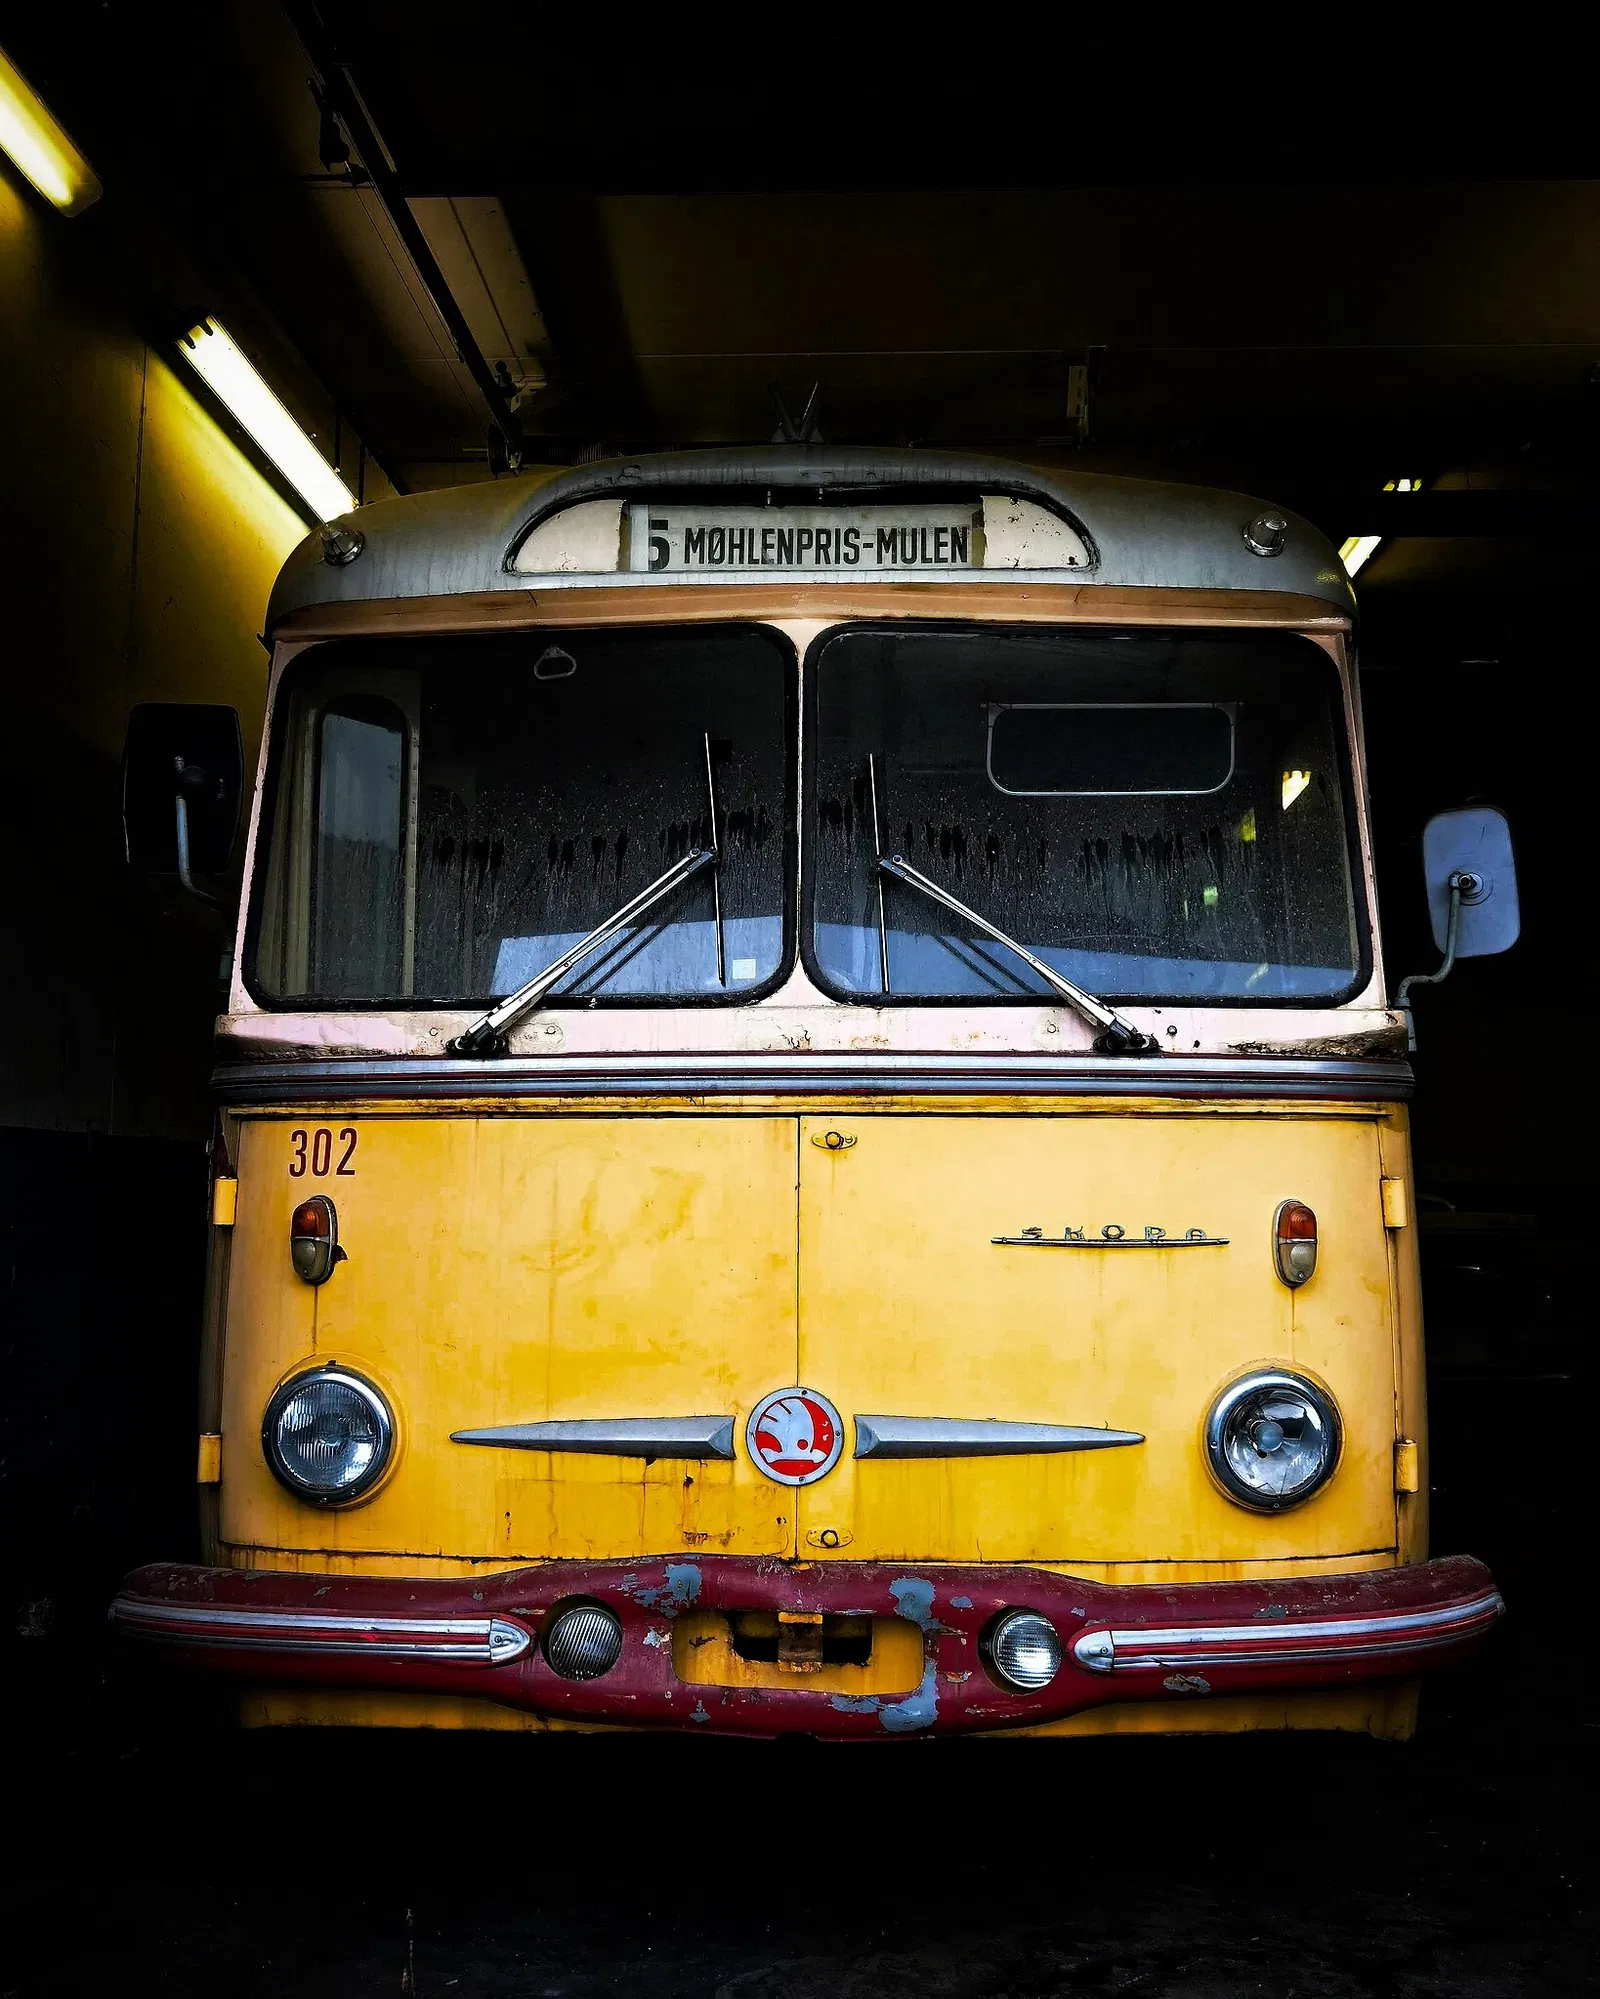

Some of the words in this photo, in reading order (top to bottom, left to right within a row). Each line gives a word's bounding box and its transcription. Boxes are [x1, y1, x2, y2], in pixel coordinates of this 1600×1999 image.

[648, 519, 671, 572] 5
[684, 526, 968, 566] MØHLENPRIS-MULEN
[289, 1127, 358, 1178] 302
